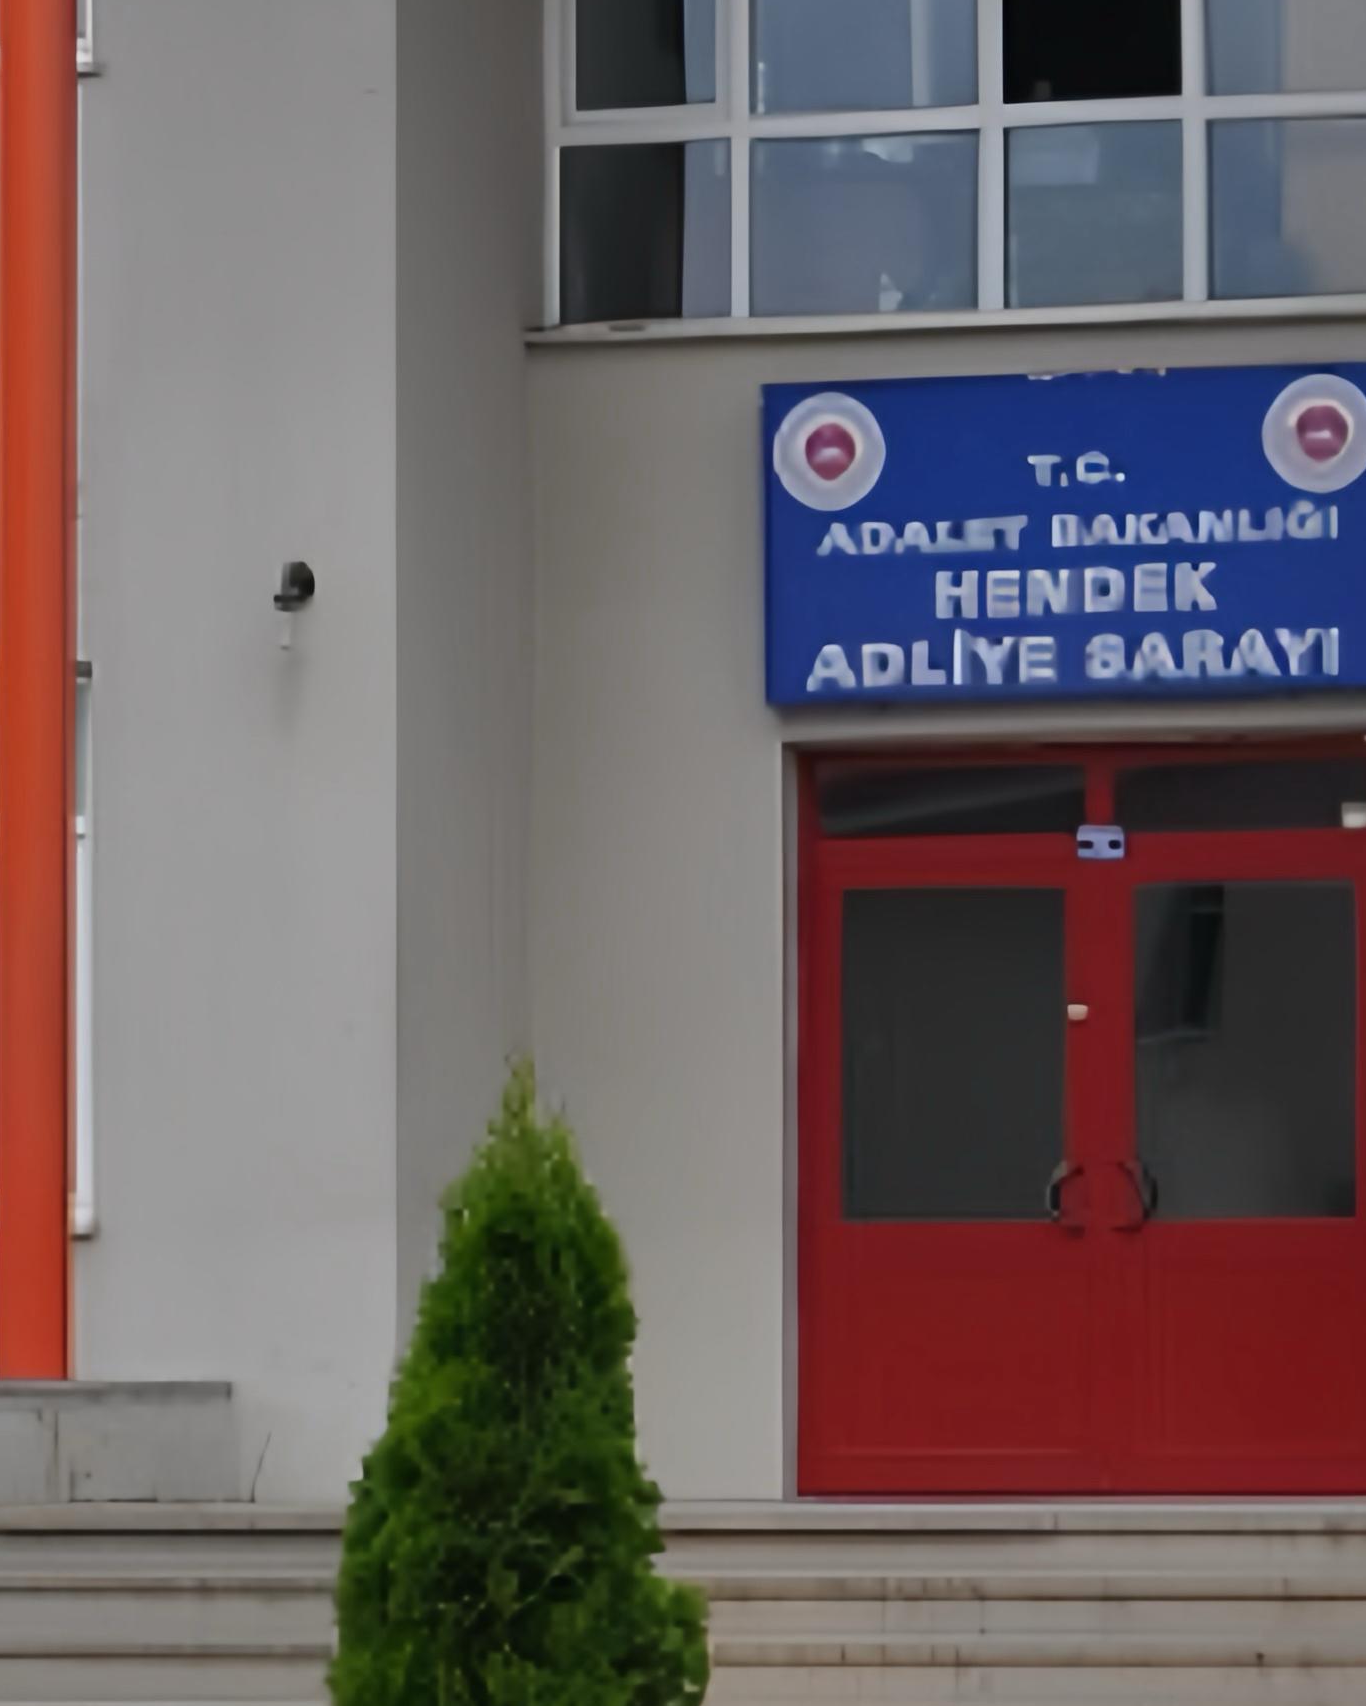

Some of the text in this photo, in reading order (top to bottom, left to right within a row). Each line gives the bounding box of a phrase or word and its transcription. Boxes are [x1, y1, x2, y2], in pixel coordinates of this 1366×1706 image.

[1026, 450, 1127, 488] T.C.
[816, 514, 1029, 557] ADALET
[935, 561, 1218, 620] HENDEK
[805, 626, 1340, 693] ADLİYE SARAYI
